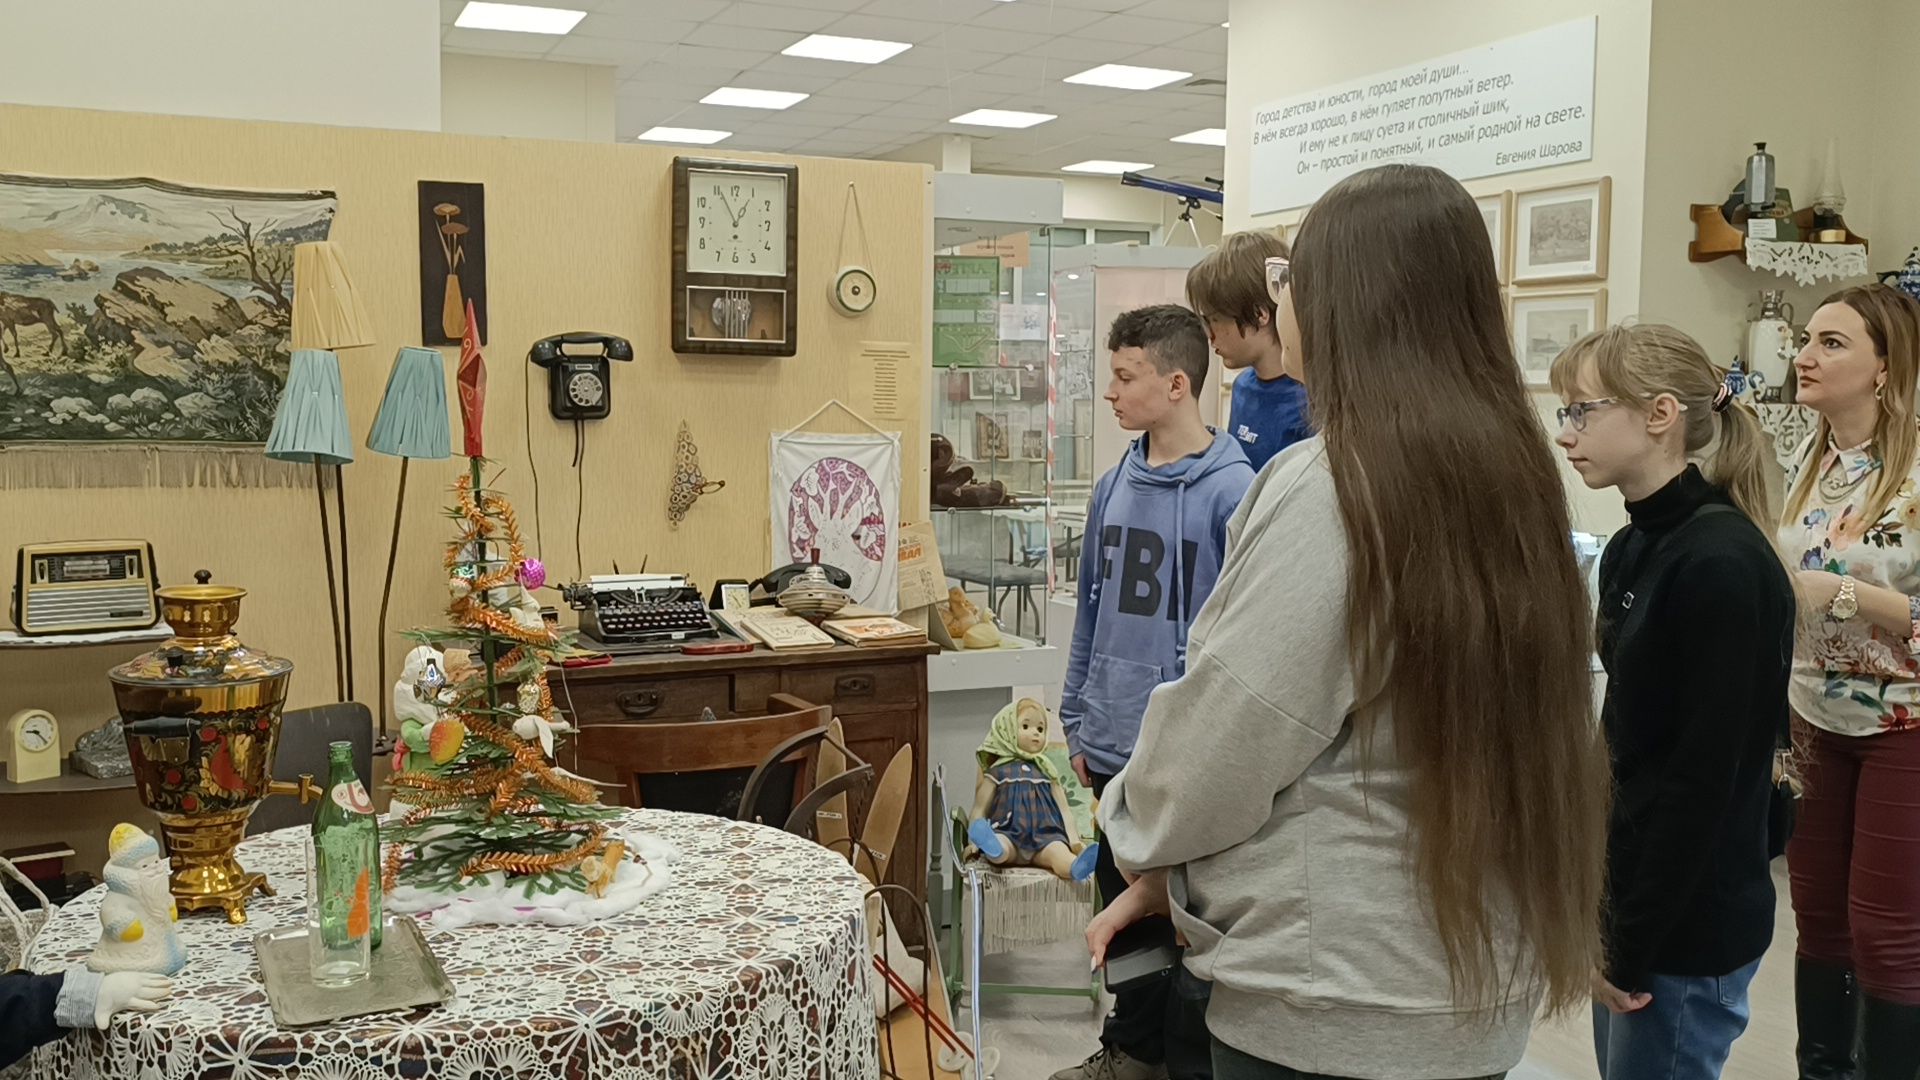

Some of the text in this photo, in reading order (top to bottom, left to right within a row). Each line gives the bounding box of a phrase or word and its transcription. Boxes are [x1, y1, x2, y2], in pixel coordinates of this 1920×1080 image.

[1256, 110, 1280, 126] Город
[1282, 101, 1316, 120] детства
[1319, 98, 1325, 110] и
[1327, 89, 1364, 107] юности,
[1368, 80, 1397, 98] город
[1400, 67, 1428, 88] моей
[1253, 73, 1514, 145] В нём всегда хорошо, в нём гуляет попутный ветер.
[1299, 98, 1510, 154] И ему не к лицу суета и столичный шик,
[1297, 160, 1310, 175] Он
[1320, 149, 1359, 172] простой
[1360, 151, 1368, 162] и
[1370, 136, 1424, 160] понятный,
[1428, 138, 1435, 149] и
[1438, 124, 1475, 148] самый
[1477, 114, 1522, 143] родной
[1525, 114, 1541, 130] на
[1544, 105, 1585, 125] свете.
[1495, 140, 1583, 166] Евгения Шарова
[713, 185, 721, 196] 11
[730, 185, 740, 197] 12
[696, 197, 706, 208] 10
[764, 200, 770, 211] 2
[699, 217, 705, 228] 9
[699, 238, 705, 249] 8
[764, 241, 771, 251] 4
[716, 251, 721, 262] 7
[732, 252, 739, 263] 6
[750, 252, 756, 263] 5
